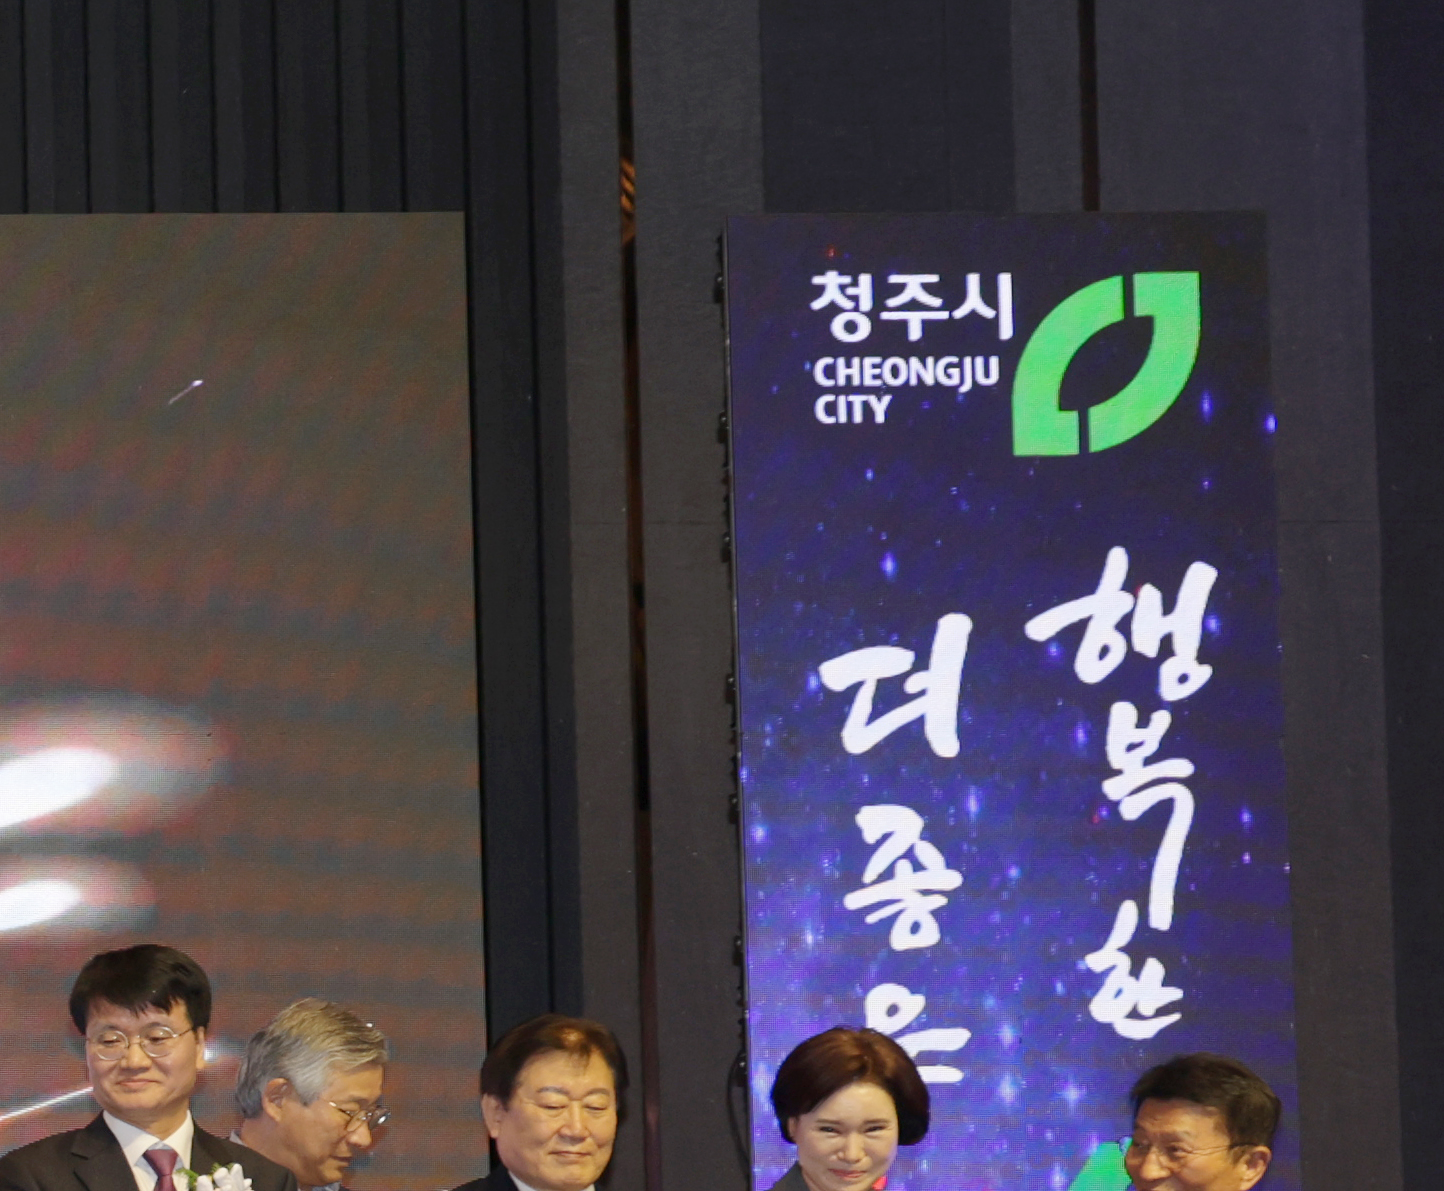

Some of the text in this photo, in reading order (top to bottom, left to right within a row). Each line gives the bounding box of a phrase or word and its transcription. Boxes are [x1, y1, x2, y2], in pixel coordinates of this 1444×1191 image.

[811, 270, 1015, 343] 청주시
[814, 355, 1000, 393] CHEONGJU
[814, 395, 893, 424] CITY
[819, 613, 973, 758] 더
[1024, 546, 1219, 1040] 행복한
[844, 804, 972, 1084] 좋은
